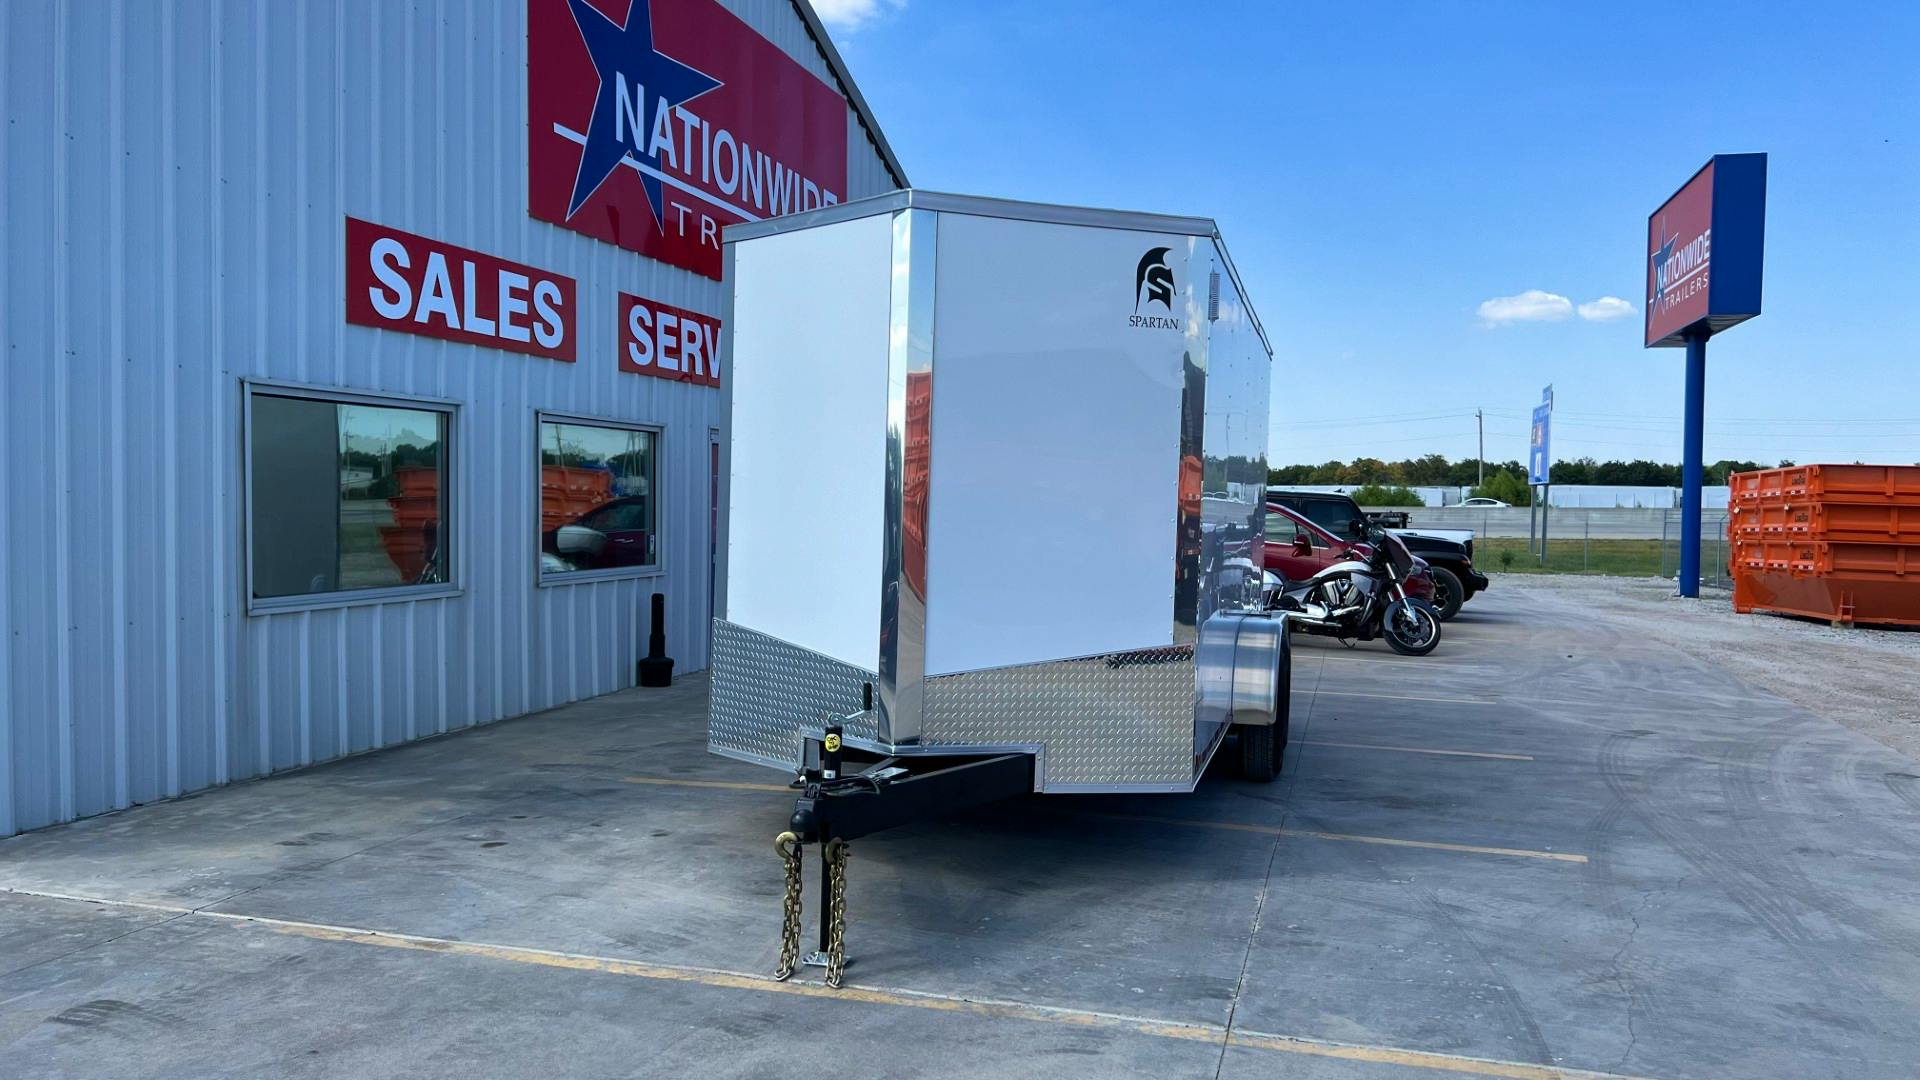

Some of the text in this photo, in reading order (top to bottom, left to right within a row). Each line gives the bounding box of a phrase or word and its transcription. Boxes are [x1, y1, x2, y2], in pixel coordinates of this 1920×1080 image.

[1657, 229, 1711, 291] NATIONWIDE
[368, 237, 564, 349] SALES
[1665, 272, 1709, 310] TRAILERS
[1129, 315, 1179, 330] SPARTAN
